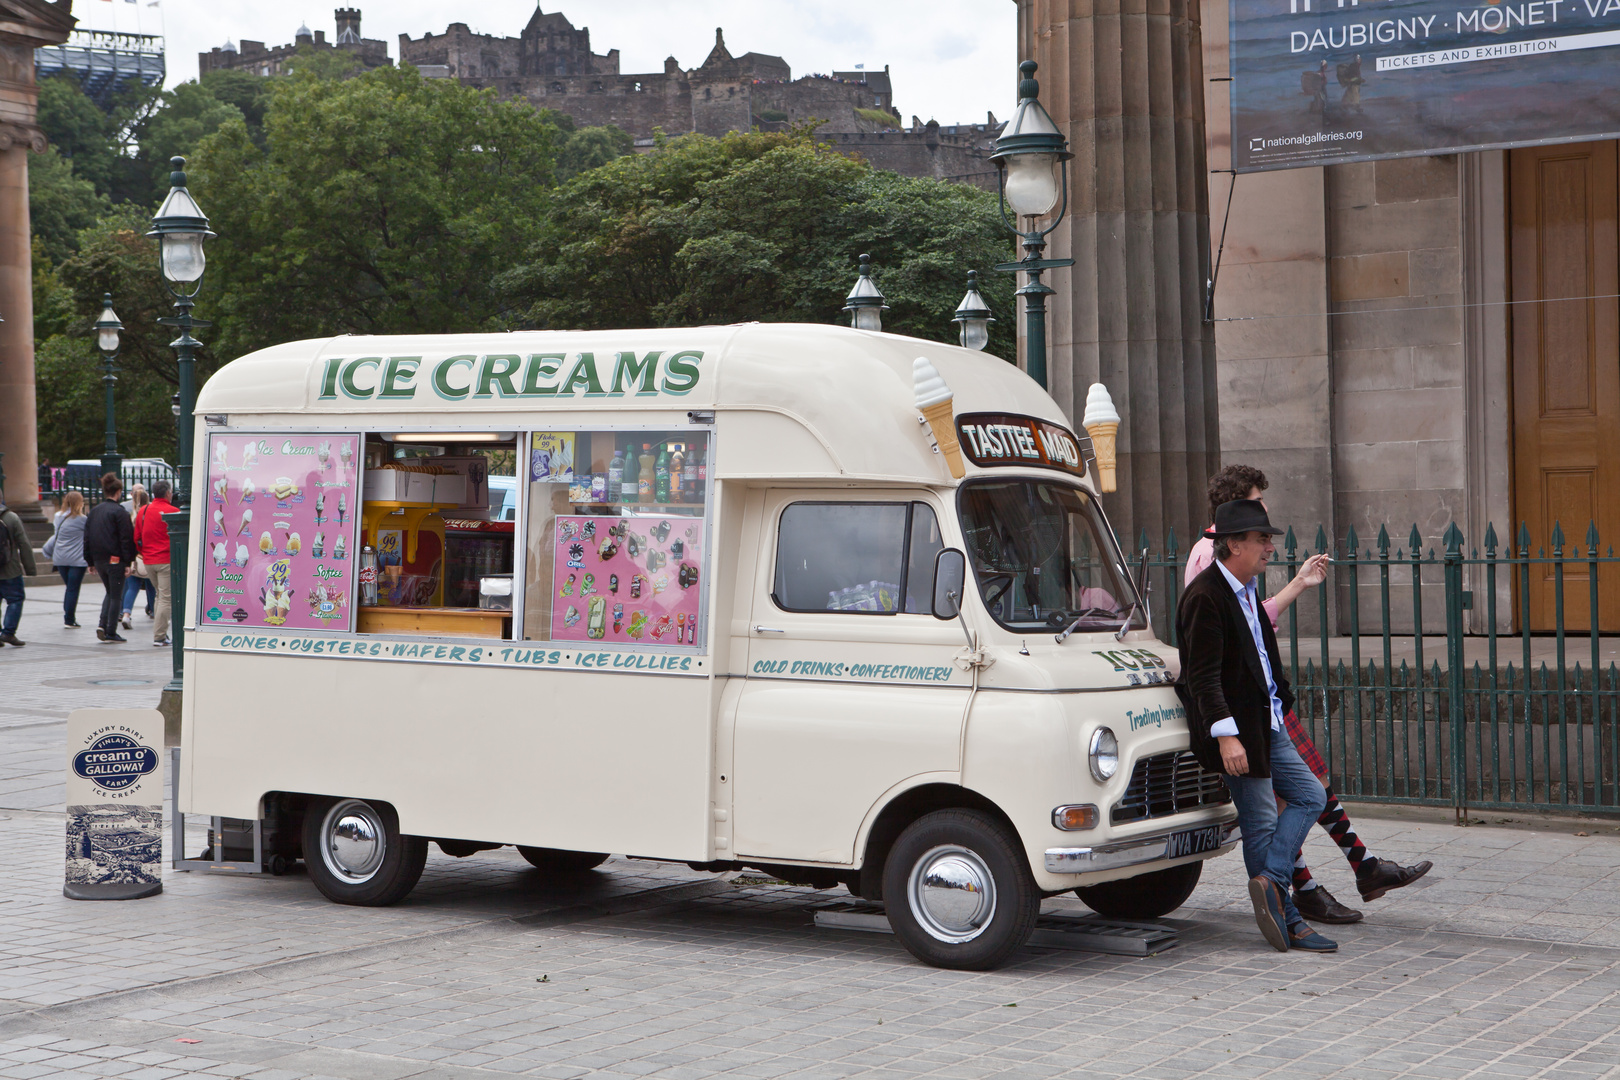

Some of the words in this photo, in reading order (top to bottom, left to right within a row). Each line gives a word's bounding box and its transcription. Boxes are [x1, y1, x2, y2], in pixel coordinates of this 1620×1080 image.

[1291, 14, 1436, 53] DAUBIGNY
[1456, 0, 1564, 34] MONET
[1380, 53, 1436, 68] TICKETS
[1441, 50, 1470, 62] AND
[1476, 40, 1557, 58] EXHIBITION
[1267, 130, 1363, 148] nationalgalleries.org
[318, 356, 422, 400] ICE
[431, 350, 705, 401] CREAMS
[257, 440, 274, 455] Ice
[281, 440, 316, 455] Cream
[961, 424, 1039, 458] TASTTEE
[1037, 429, 1079, 467] MAID
[216, 568, 243, 584] Scoop
[312, 564, 343, 580] Softee
[220, 635, 278, 649] CONES
[289, 638, 382, 655] OYSTERS
[392, 643, 484, 662] WAFERS
[501, 648, 561, 664] TUBS
[575, 652, 612, 667] ICE
[613, 653, 692, 671] LOLLIES
[1091, 648, 1166, 672] ICES
[753, 659, 789, 674] COLD
[791, 660, 844, 676] DRINKS
[849, 663, 953, 681] CONFECTIONERY
[1126, 707, 1161, 731] Trading
[1159, 704, 1176, 720] here
[84, 725, 116, 745] LUXURY
[119, 725, 144, 741] DAIRY
[98, 737, 132, 749] FINLAY'S
[84, 752, 130, 763] cream
[135, 749, 148, 760] o'
[85, 762, 145, 775] GALLOWAY
[92, 787, 107, 798] ICE
[111, 784, 142, 798] CREAM
[105, 779, 128, 787] FARM
[1170, 832, 1192, 858] WVA
[1194, 826, 1222, 853] 773H
